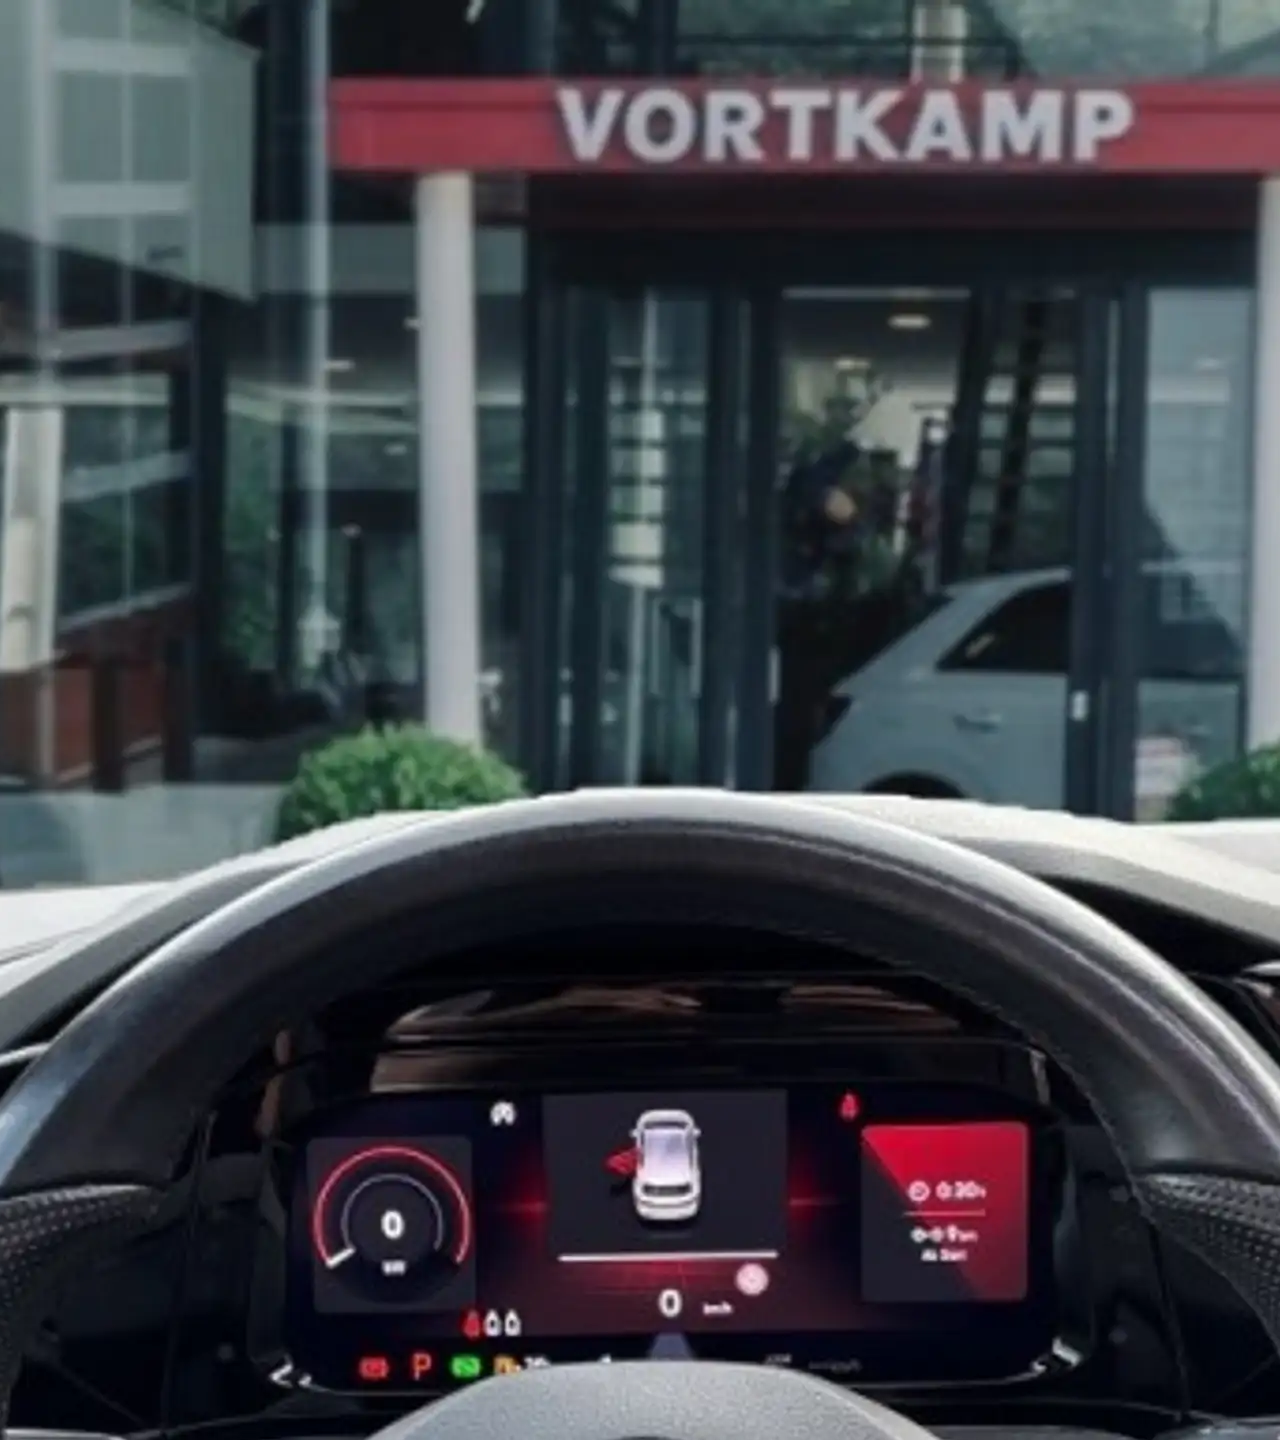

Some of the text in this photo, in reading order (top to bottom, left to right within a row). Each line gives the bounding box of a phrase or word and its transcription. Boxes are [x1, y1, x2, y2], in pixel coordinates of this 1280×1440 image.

[558, 87, 1134, 163] VORTKAMP
[381, 1209, 405, 1239] 0
[658, 1288, 682, 1317] 0
